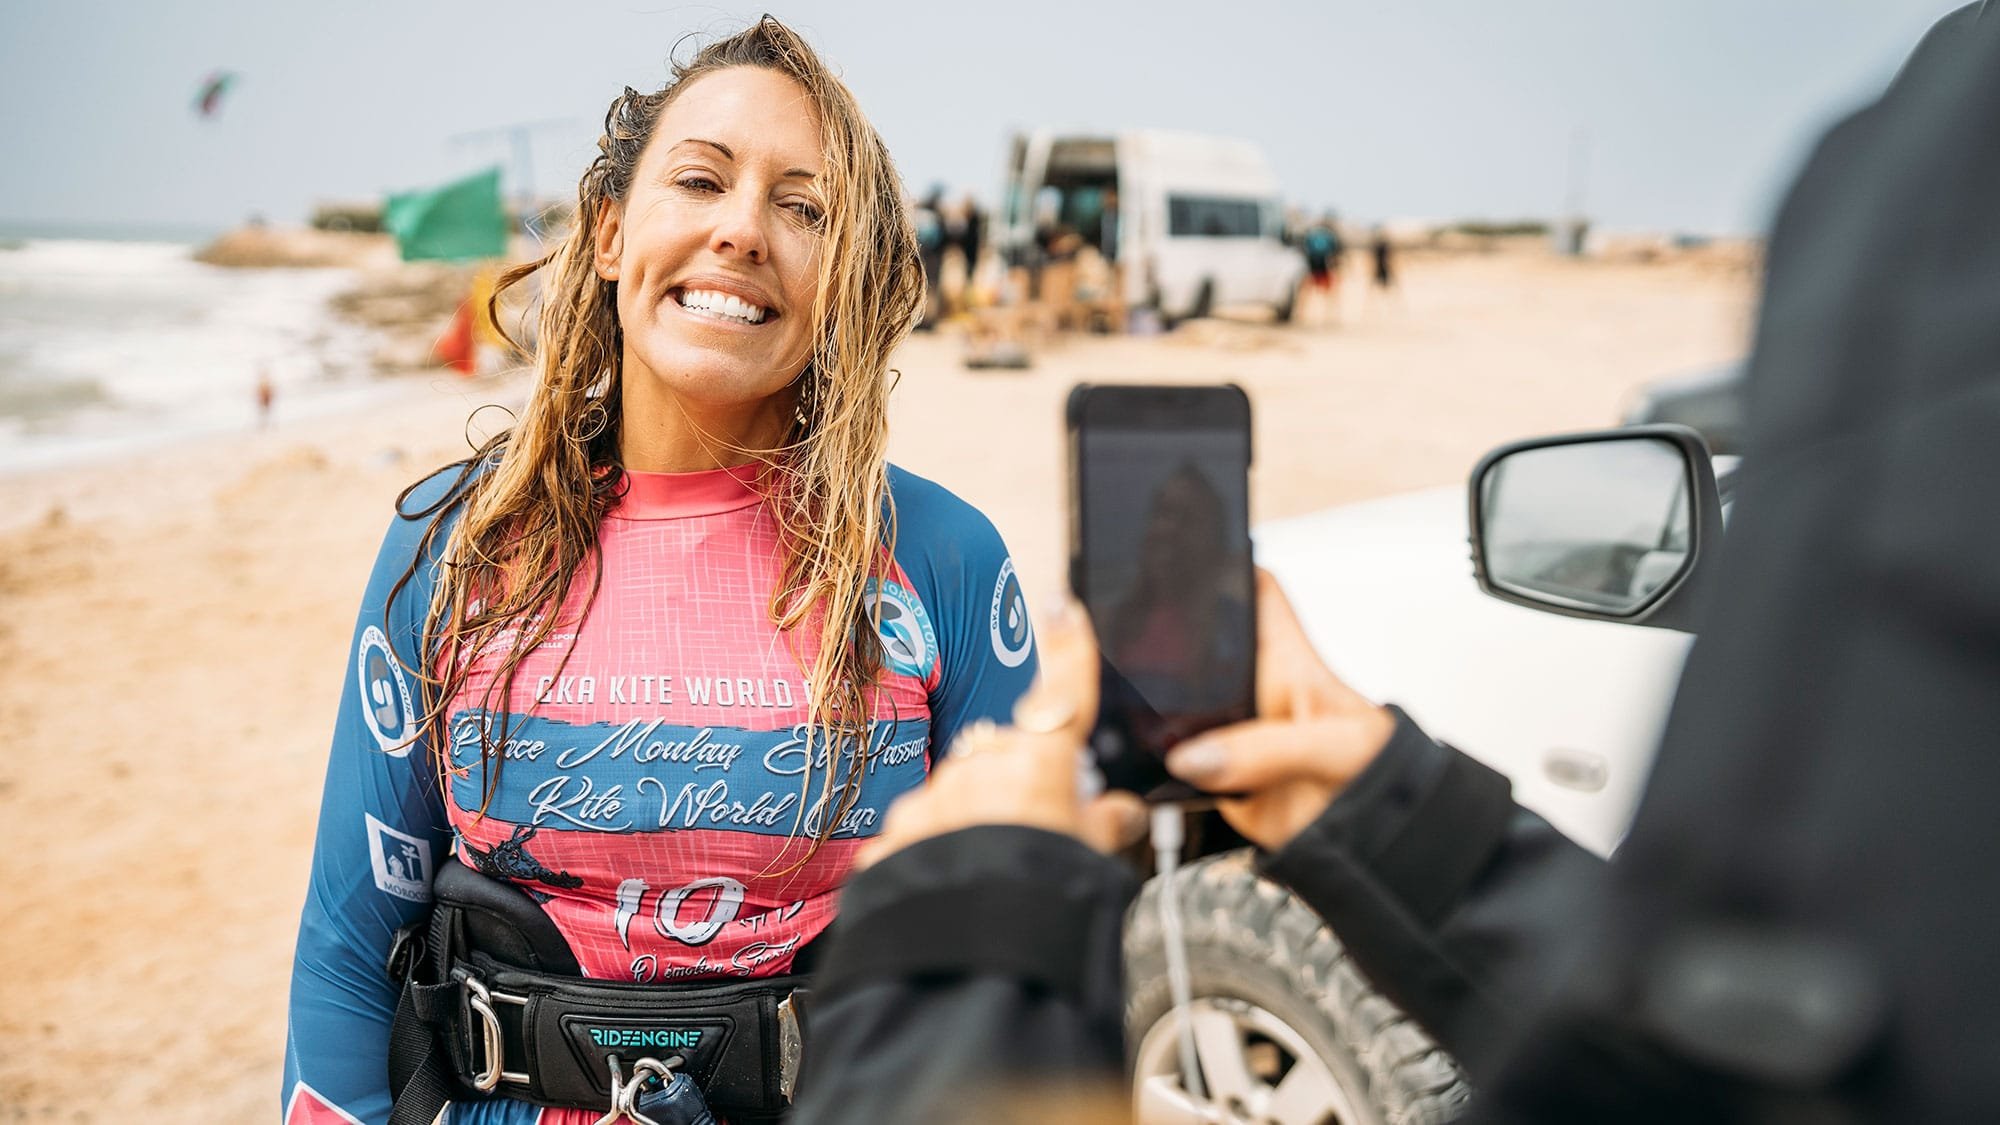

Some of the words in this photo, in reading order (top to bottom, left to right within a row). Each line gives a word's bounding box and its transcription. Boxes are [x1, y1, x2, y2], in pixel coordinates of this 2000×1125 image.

[535, 676, 596, 705] GKA
[609, 676, 673, 705] KITE
[684, 677, 793, 708] WORLD
[453, 715, 550, 760] Pince
[556, 716, 743, 773] Moulay
[528, 775, 633, 831] Kite
[637, 776, 798, 828] World
[803, 783, 879, 839] Cup
[615, 876, 749, 953] 10
[589, 1028, 702, 1048] RIDEENGINE
